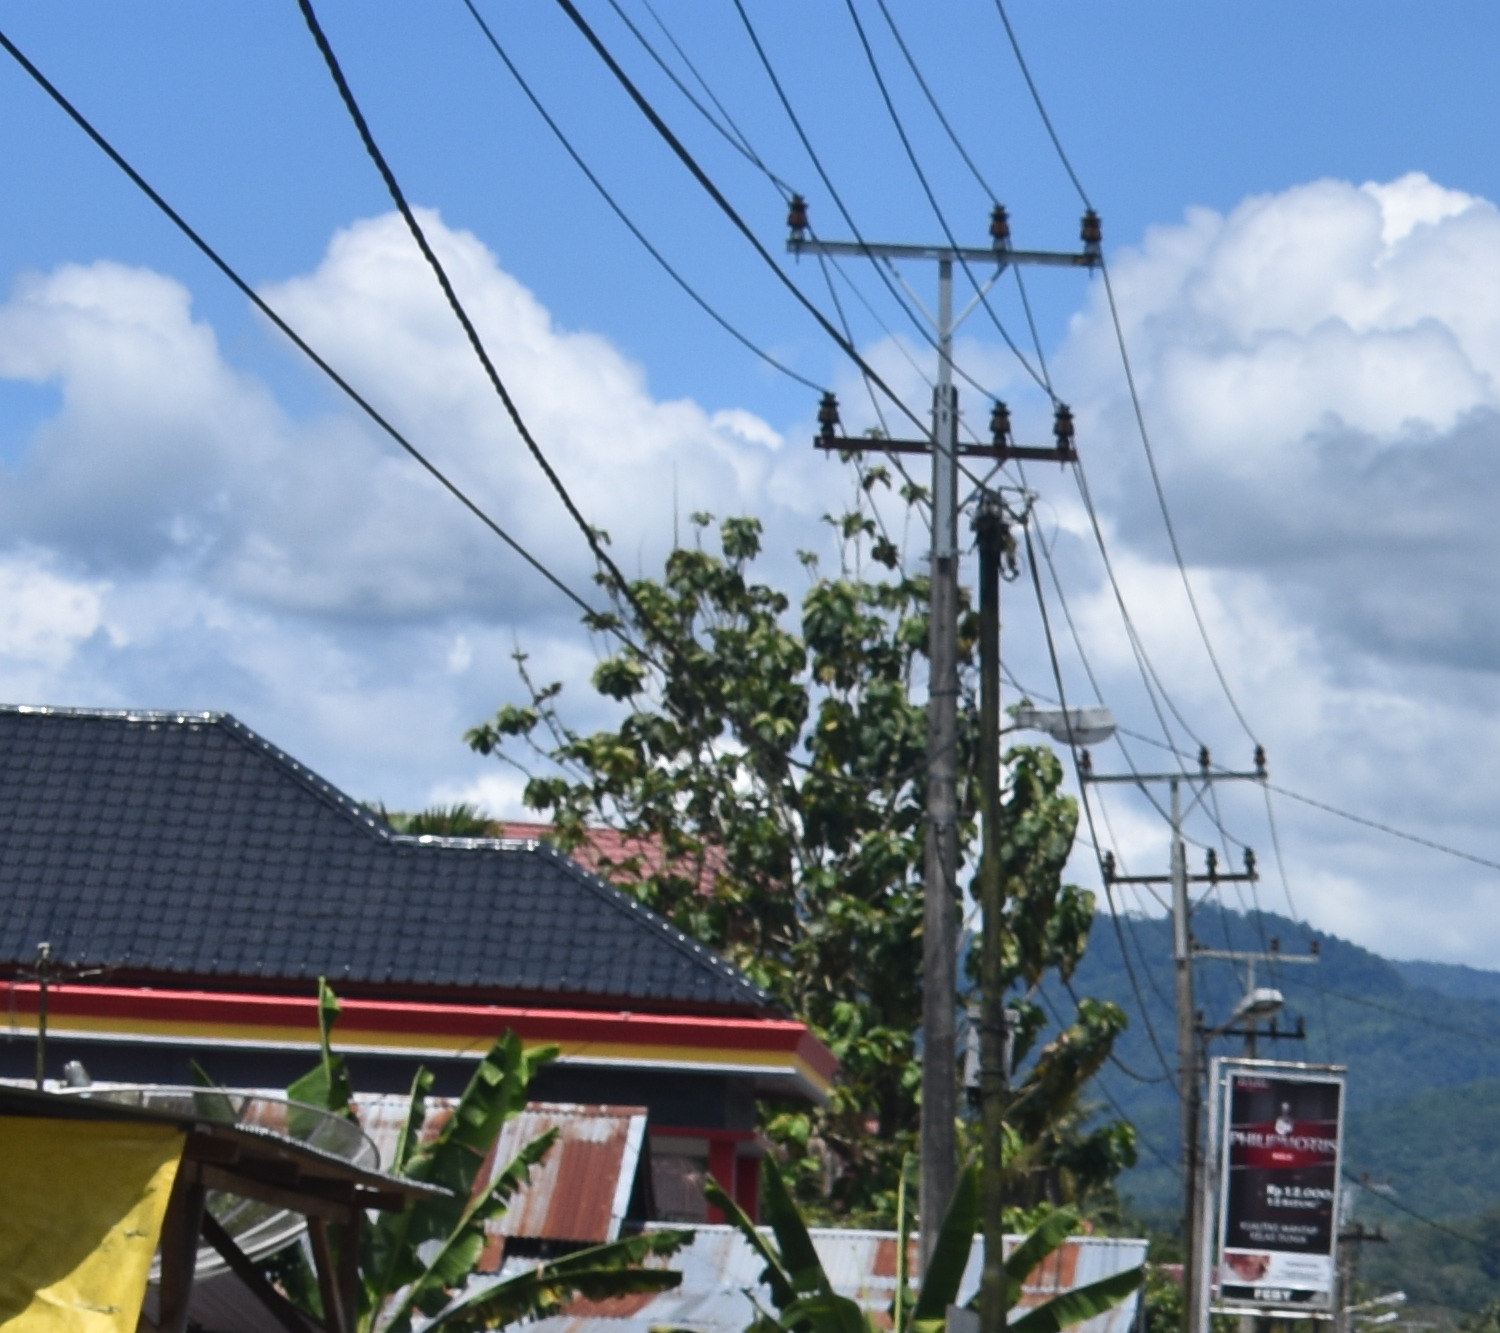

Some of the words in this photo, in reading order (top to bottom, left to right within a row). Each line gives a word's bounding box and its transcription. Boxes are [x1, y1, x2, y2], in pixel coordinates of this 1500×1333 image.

[1229, 1130, 1276, 1149] PHILIP
[1277, 1135, 1337, 1154] MORRIS
[1266, 1184, 1282, 1198] Rp
[1254, 1289, 1291, 1301] FEBY
